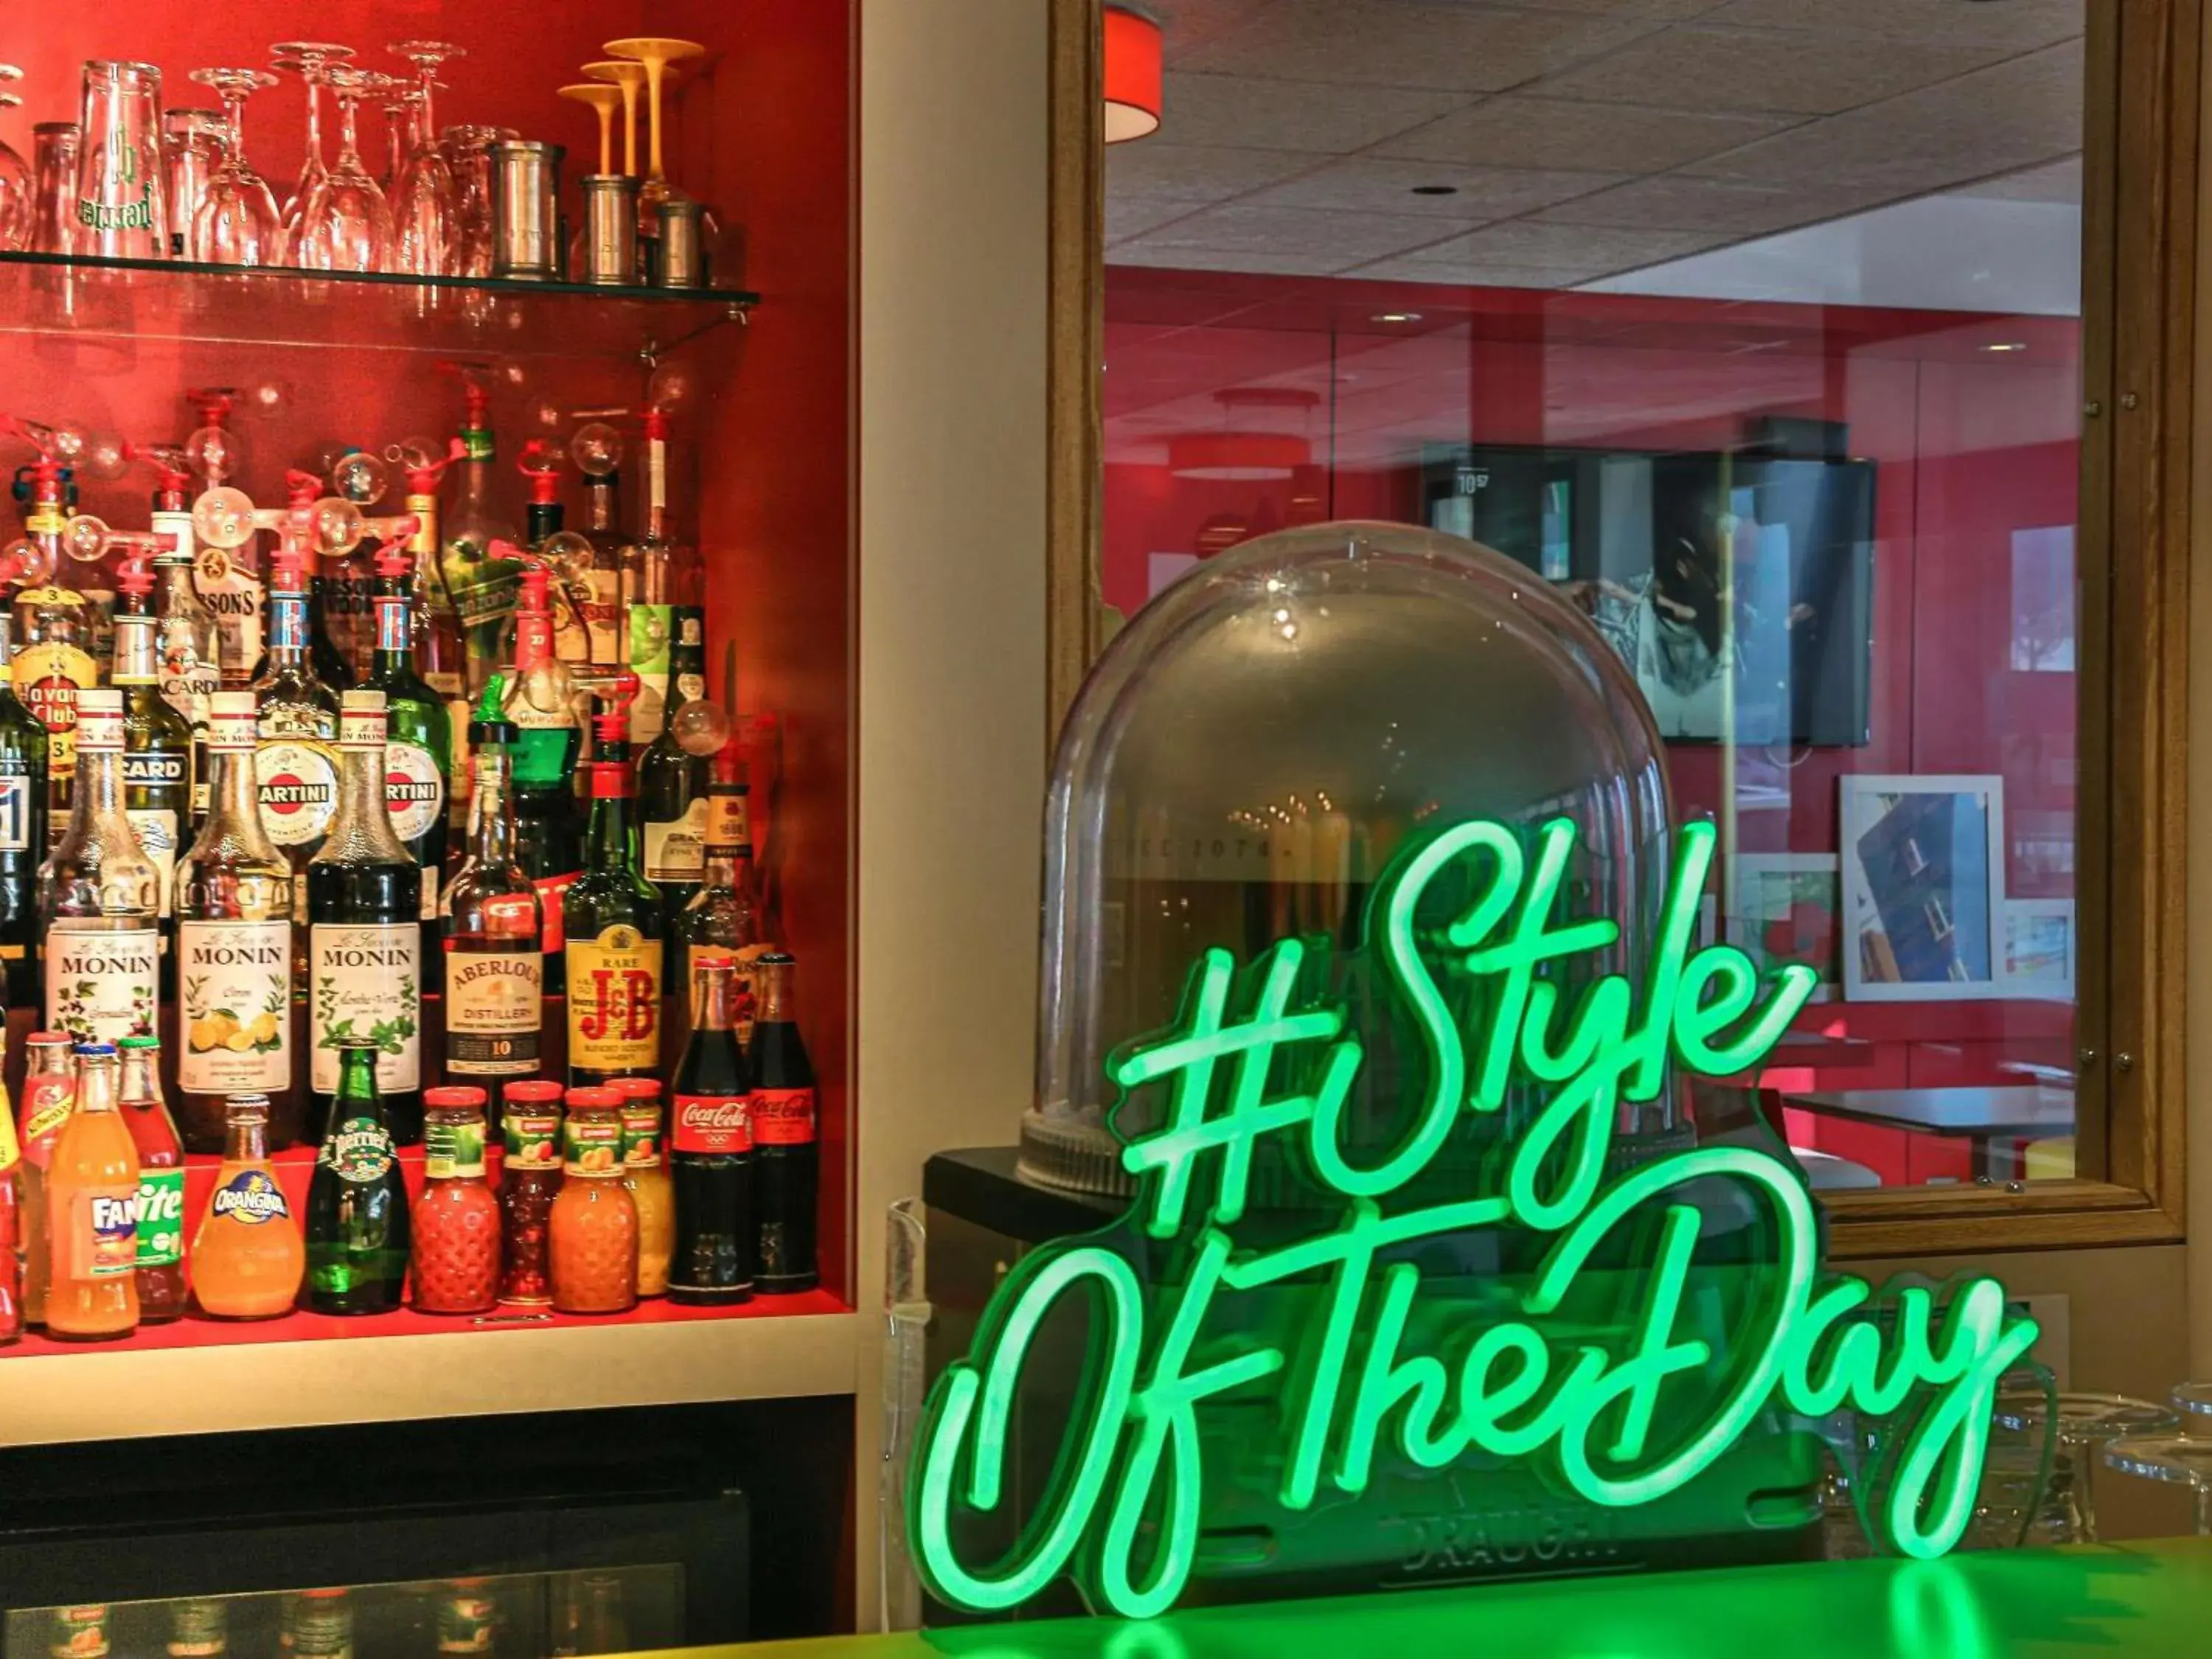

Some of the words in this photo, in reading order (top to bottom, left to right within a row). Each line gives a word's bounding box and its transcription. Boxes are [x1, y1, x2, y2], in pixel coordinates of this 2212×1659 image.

[80, 182, 153, 234] perrie
[19, 681, 77, 703] Havan
[52, 742, 64, 757] 3
[123, 760, 181, 778] CARD
[259, 785, 327, 802] ARTINI
[386, 783, 435, 800] RTINI
[192, 947, 282, 965] MONIN
[323, 949, 412, 966] MONIN
[602, 959, 640, 967] RARE
[61, 957, 152, 974] MONIN
[579, 970, 655, 1040] J&B
[1117, 815, 1819, 1237] #Style
[492, 1040, 512, 1056] 10
[682, 1102, 747, 1127] Coca-Cola
[92, 1191, 142, 1229] FAN
[136, 1183, 183, 1222] ite
[215, 1189, 285, 1214] ORANGINA
